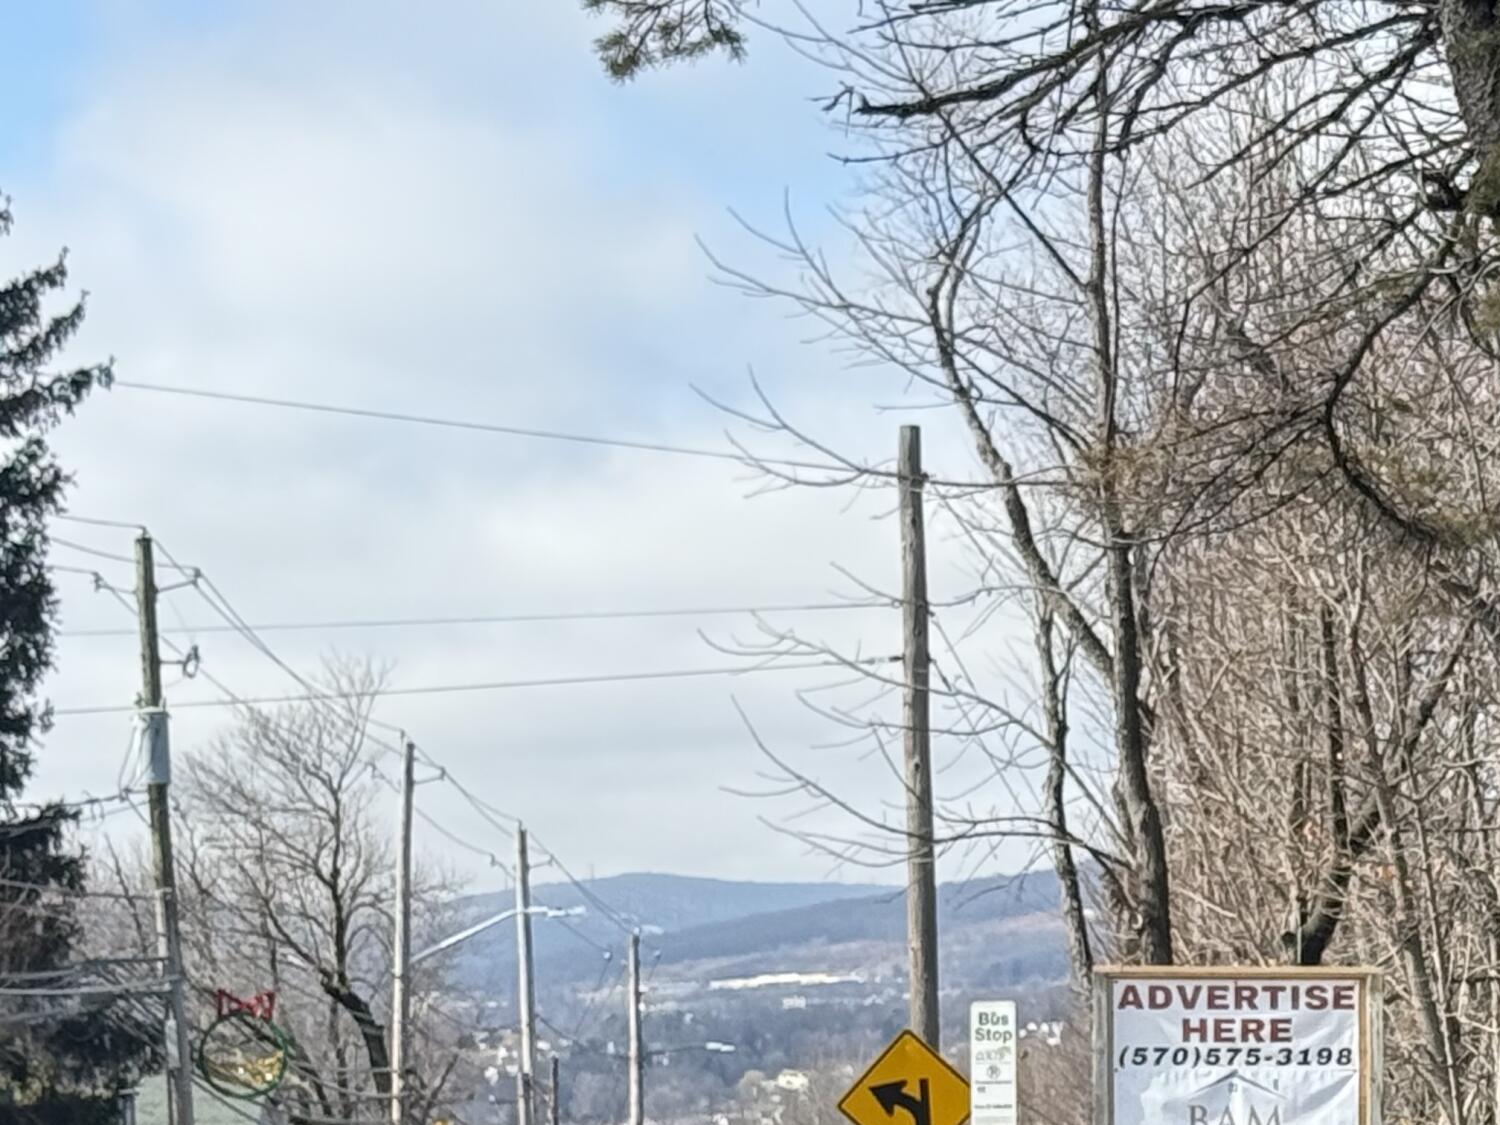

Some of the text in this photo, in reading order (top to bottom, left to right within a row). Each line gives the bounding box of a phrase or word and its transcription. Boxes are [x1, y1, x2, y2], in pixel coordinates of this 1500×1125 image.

[1117, 984, 1356, 1011] ADVERTISE
[978, 1011, 1009, 1026] Bus
[974, 1028, 1013, 1043] Stop
[1181, 1018, 1293, 1043] HERE
[1118, 1046, 1353, 1069] (570)575-3198
